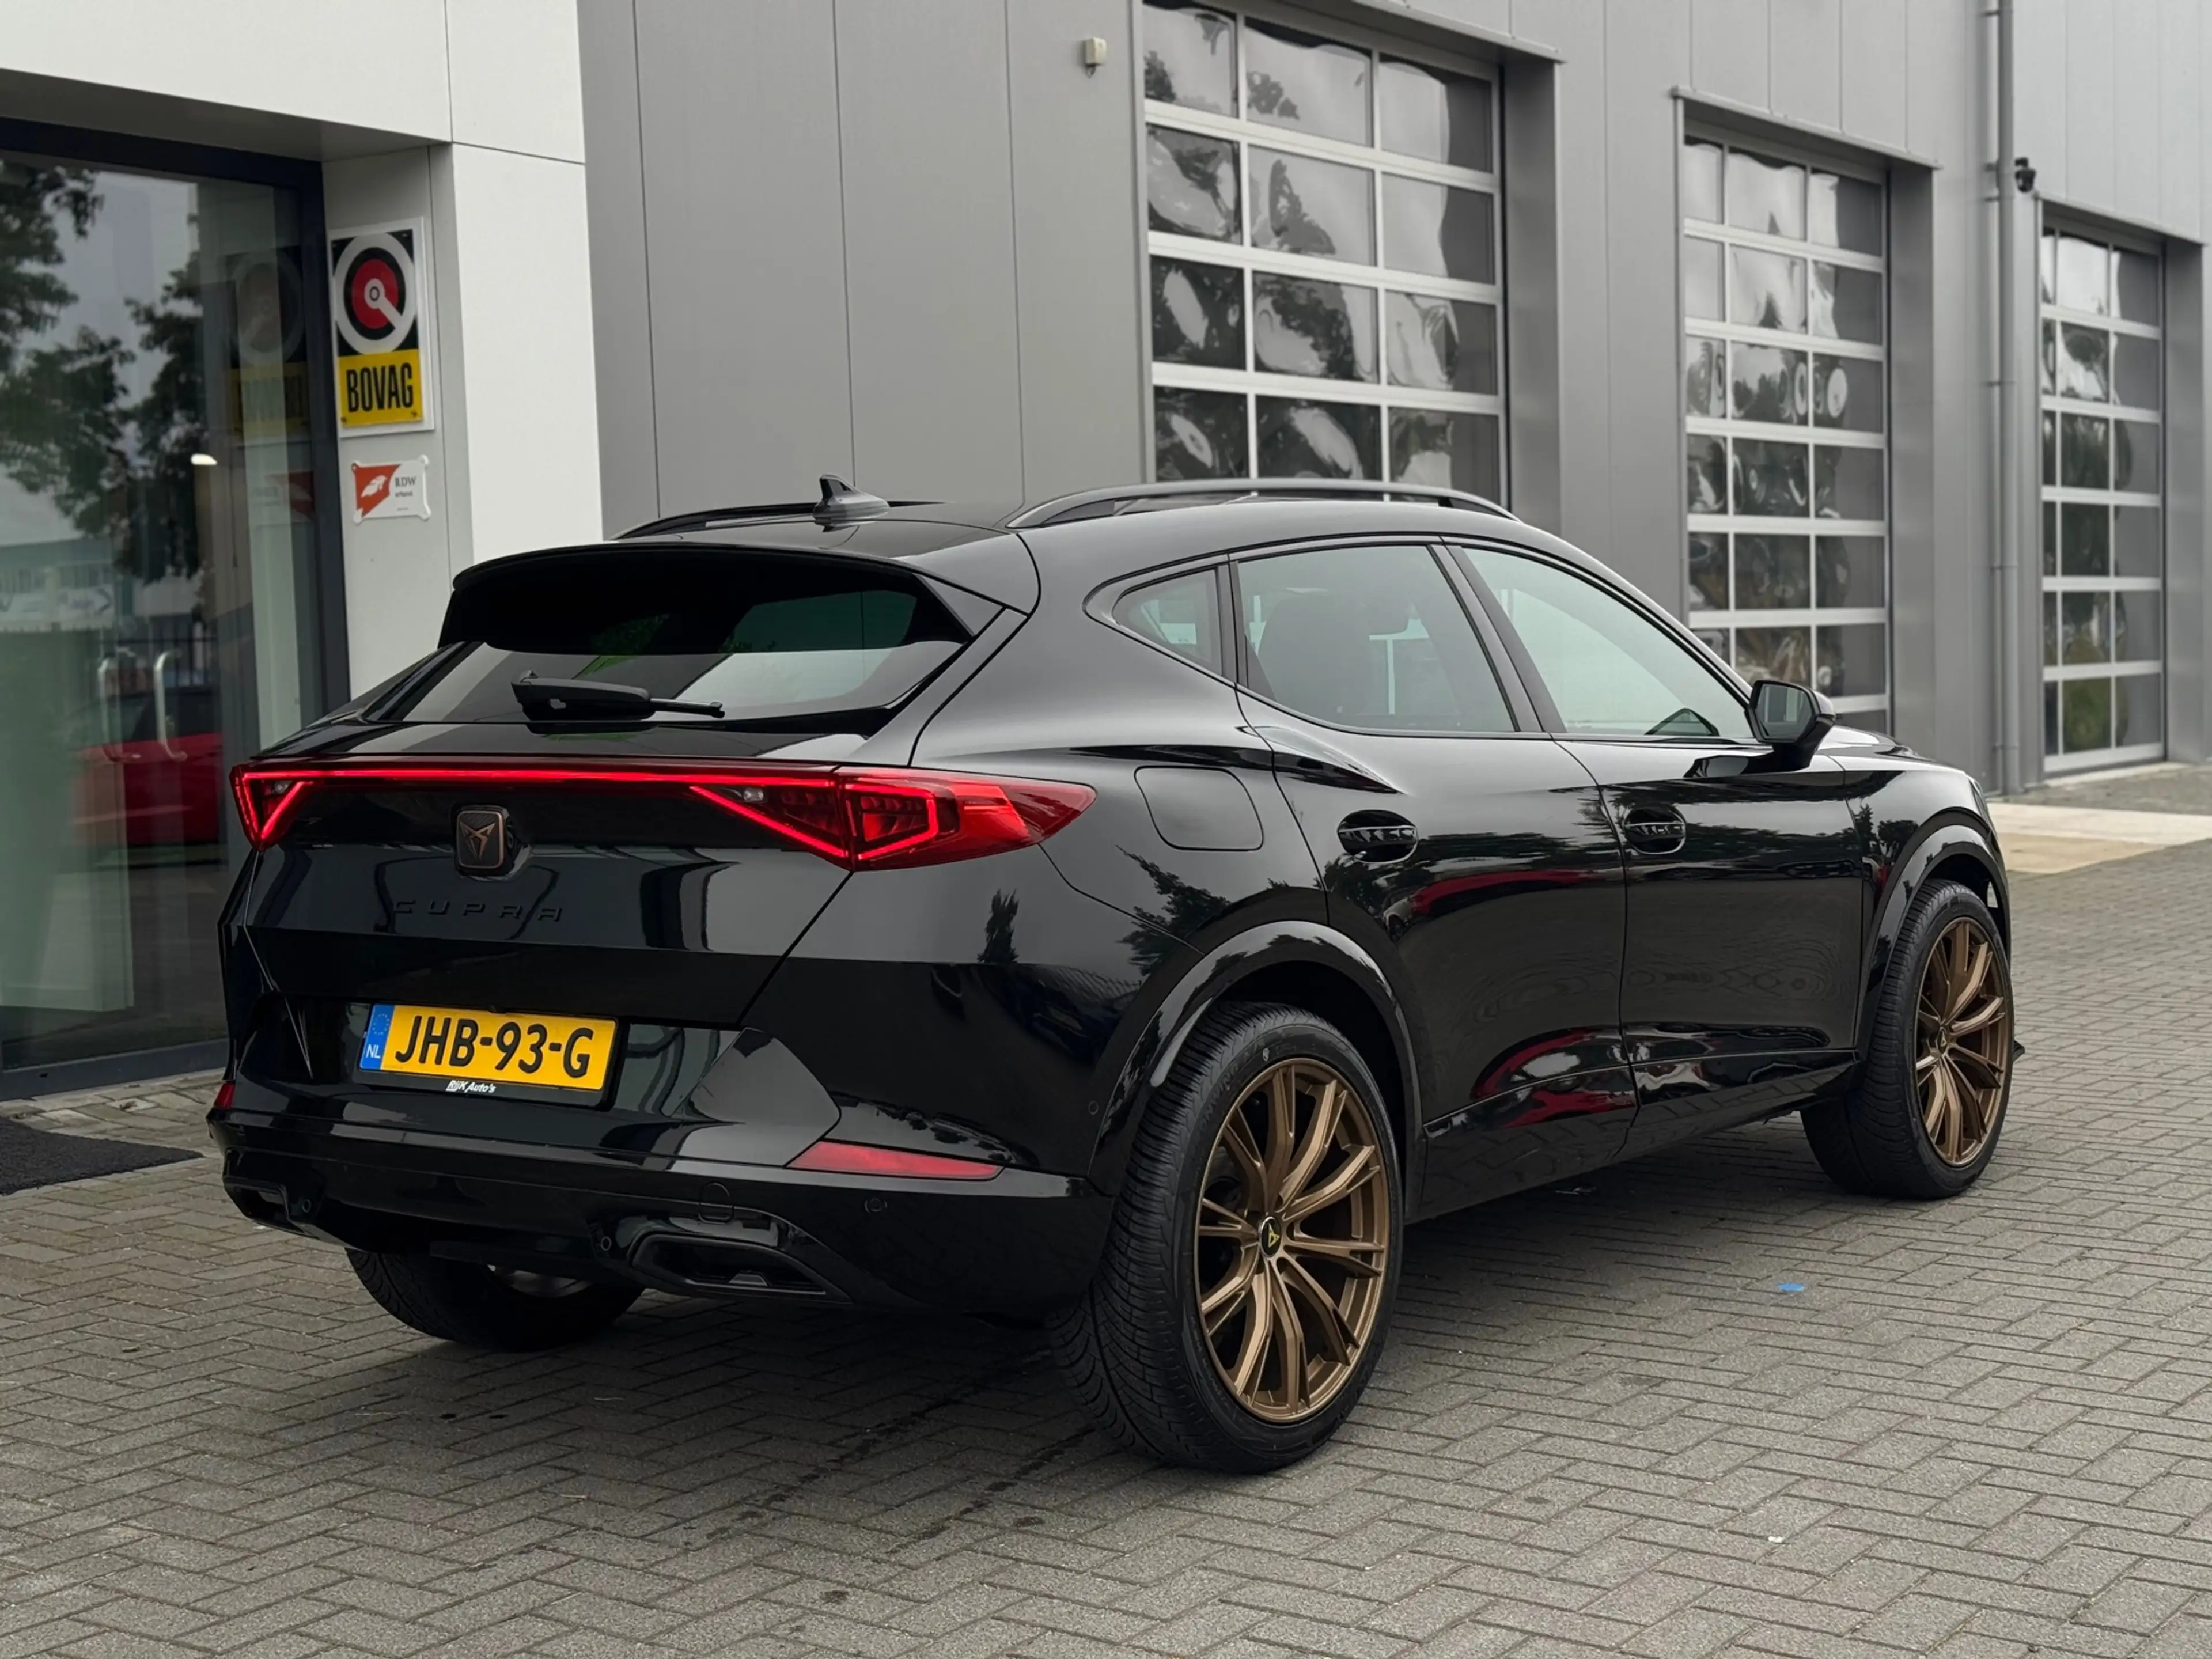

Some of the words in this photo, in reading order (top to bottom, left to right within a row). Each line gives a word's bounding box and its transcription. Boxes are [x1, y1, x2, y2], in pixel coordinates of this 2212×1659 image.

[346, 362, 414, 413] BOVAG
[393, 900, 563, 923] CUPRA
[366, 1043, 381, 1059] NL
[395, 1015, 594, 1078] JHB-93-G
[464, 1081, 497, 1093] Auto's
